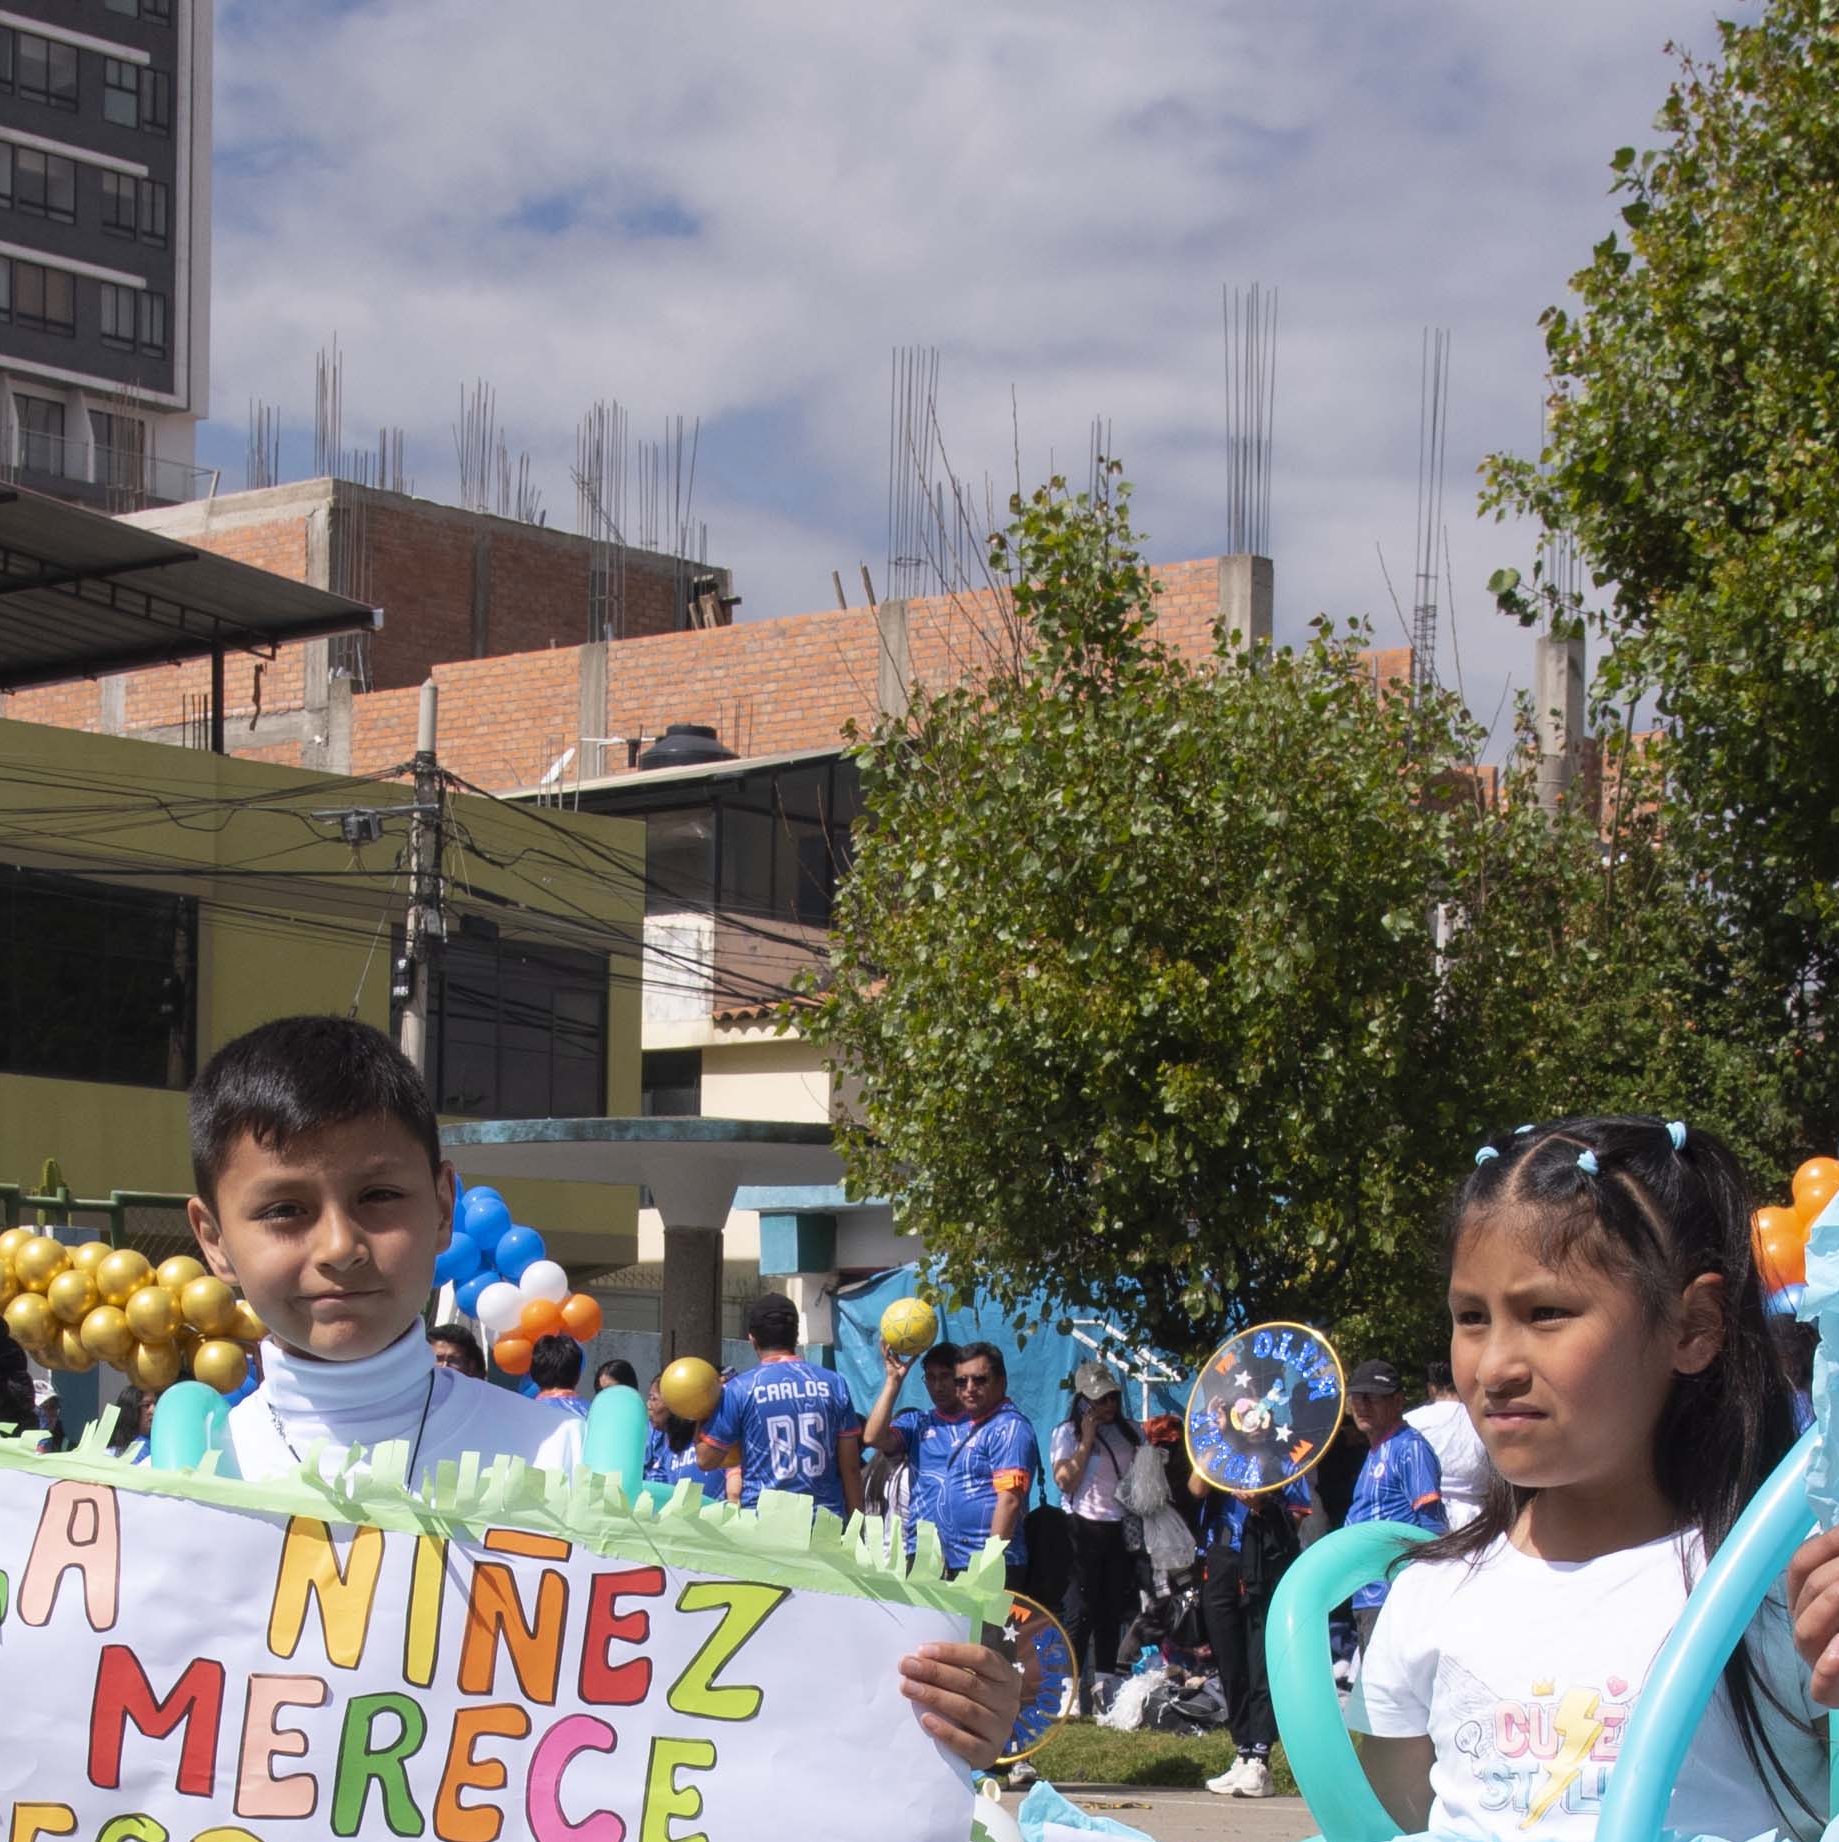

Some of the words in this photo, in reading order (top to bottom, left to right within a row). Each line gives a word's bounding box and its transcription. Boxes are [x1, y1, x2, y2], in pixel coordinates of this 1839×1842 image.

[753, 1379, 830, 1405] CARLOS
[767, 1410, 827, 1480] 85
[267, 1514, 792, 1721] NIÑEZ
